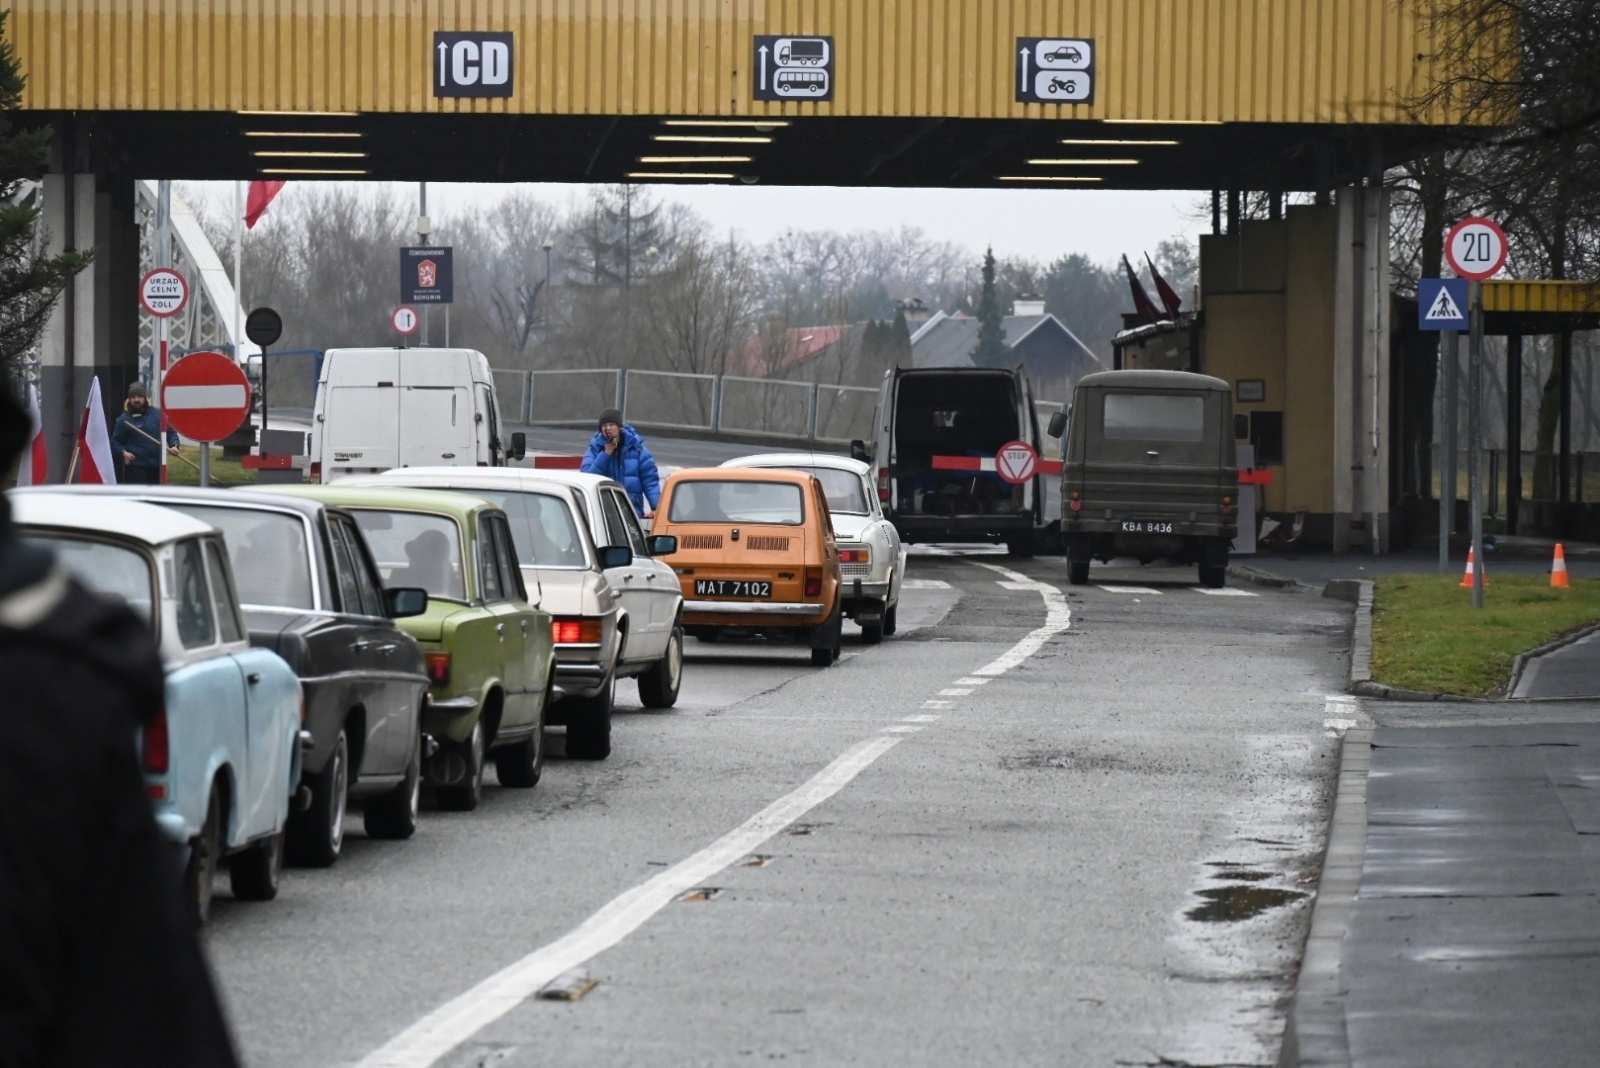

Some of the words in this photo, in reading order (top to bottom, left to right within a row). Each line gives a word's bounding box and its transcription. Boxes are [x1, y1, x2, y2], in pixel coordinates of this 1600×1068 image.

[452, 40, 509, 86] CD
[1463, 232, 1490, 262] 20
[1007, 452, 1027, 460] STOP
[1122, 521, 1142, 532] KBA
[1147, 522, 1172, 533] 8436
[697, 580, 726, 595] WAT
[733, 581, 769, 596] 7102
